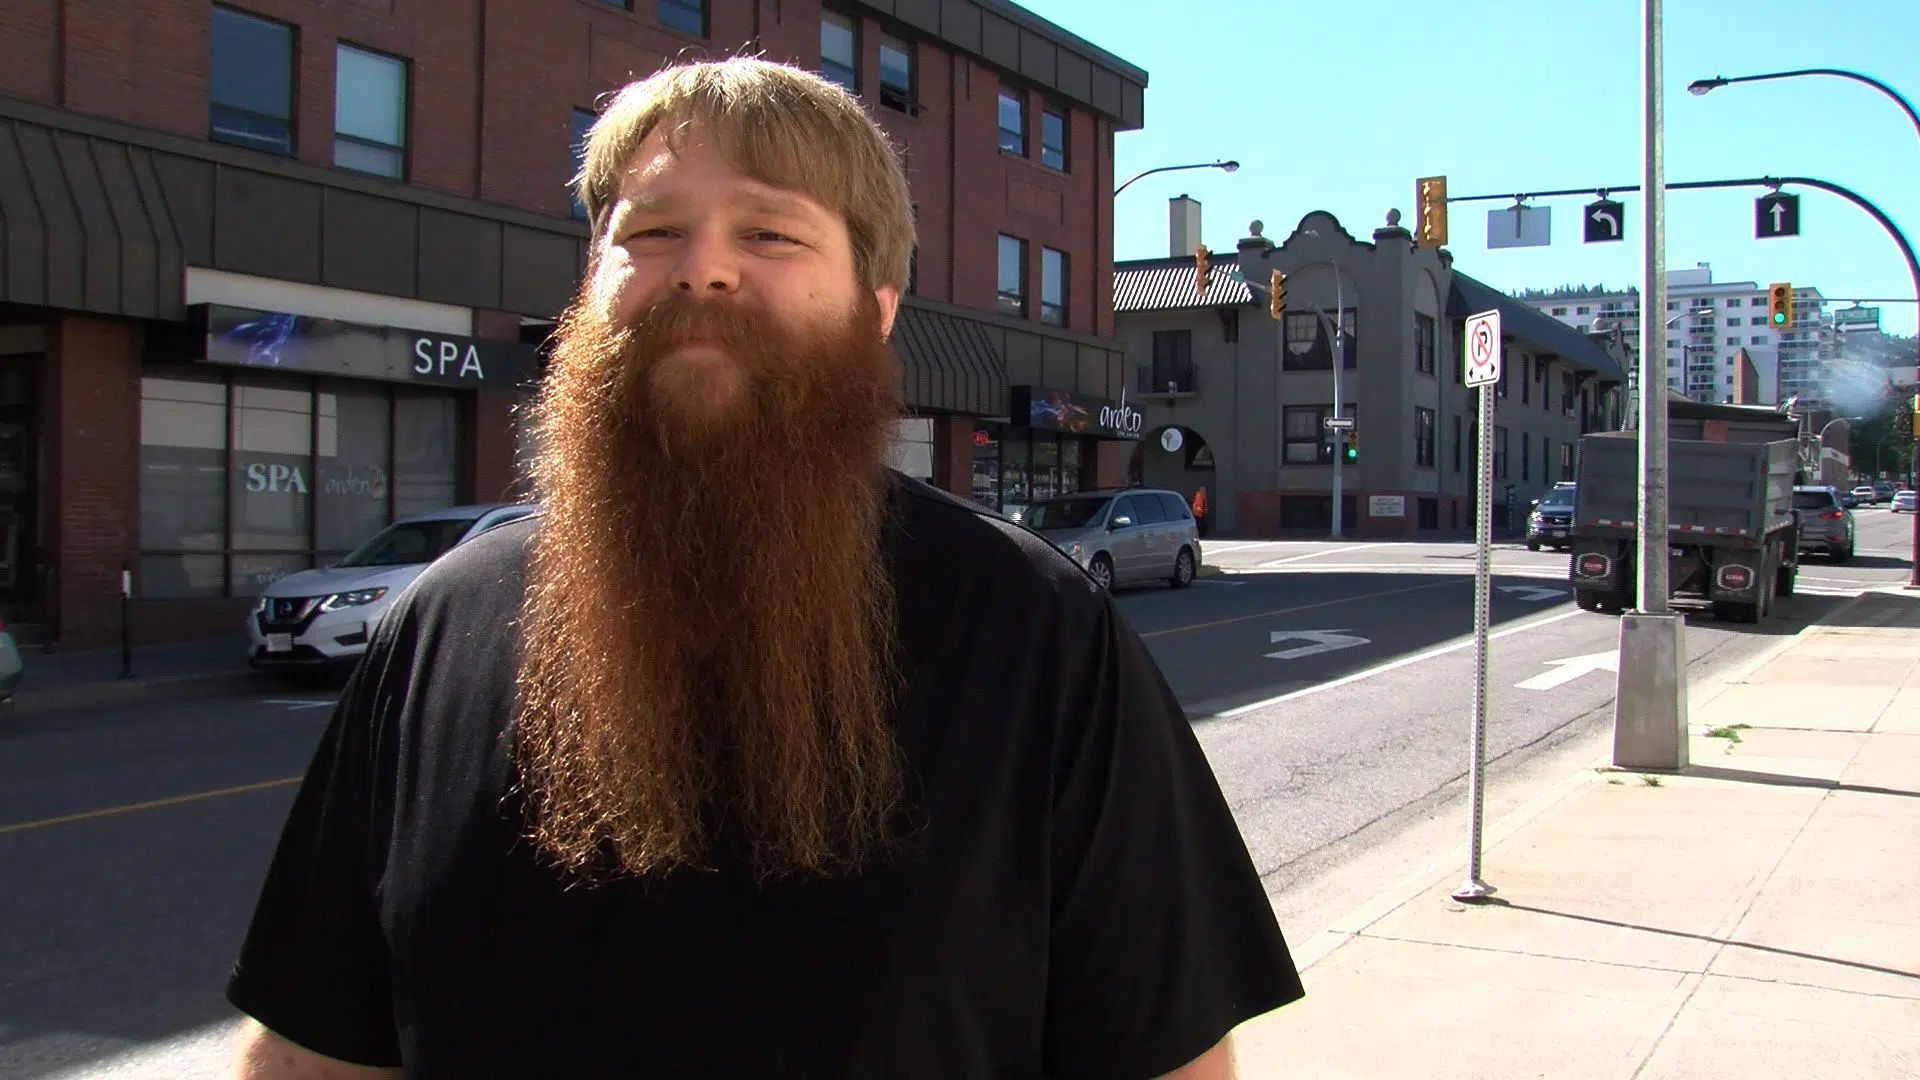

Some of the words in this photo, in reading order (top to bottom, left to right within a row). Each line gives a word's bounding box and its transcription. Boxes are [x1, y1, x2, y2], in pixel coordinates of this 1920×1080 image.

[414, 338, 484, 380] SPA
[1099, 386, 1142, 432] ardeo
[245, 463, 308, 494] SPA
